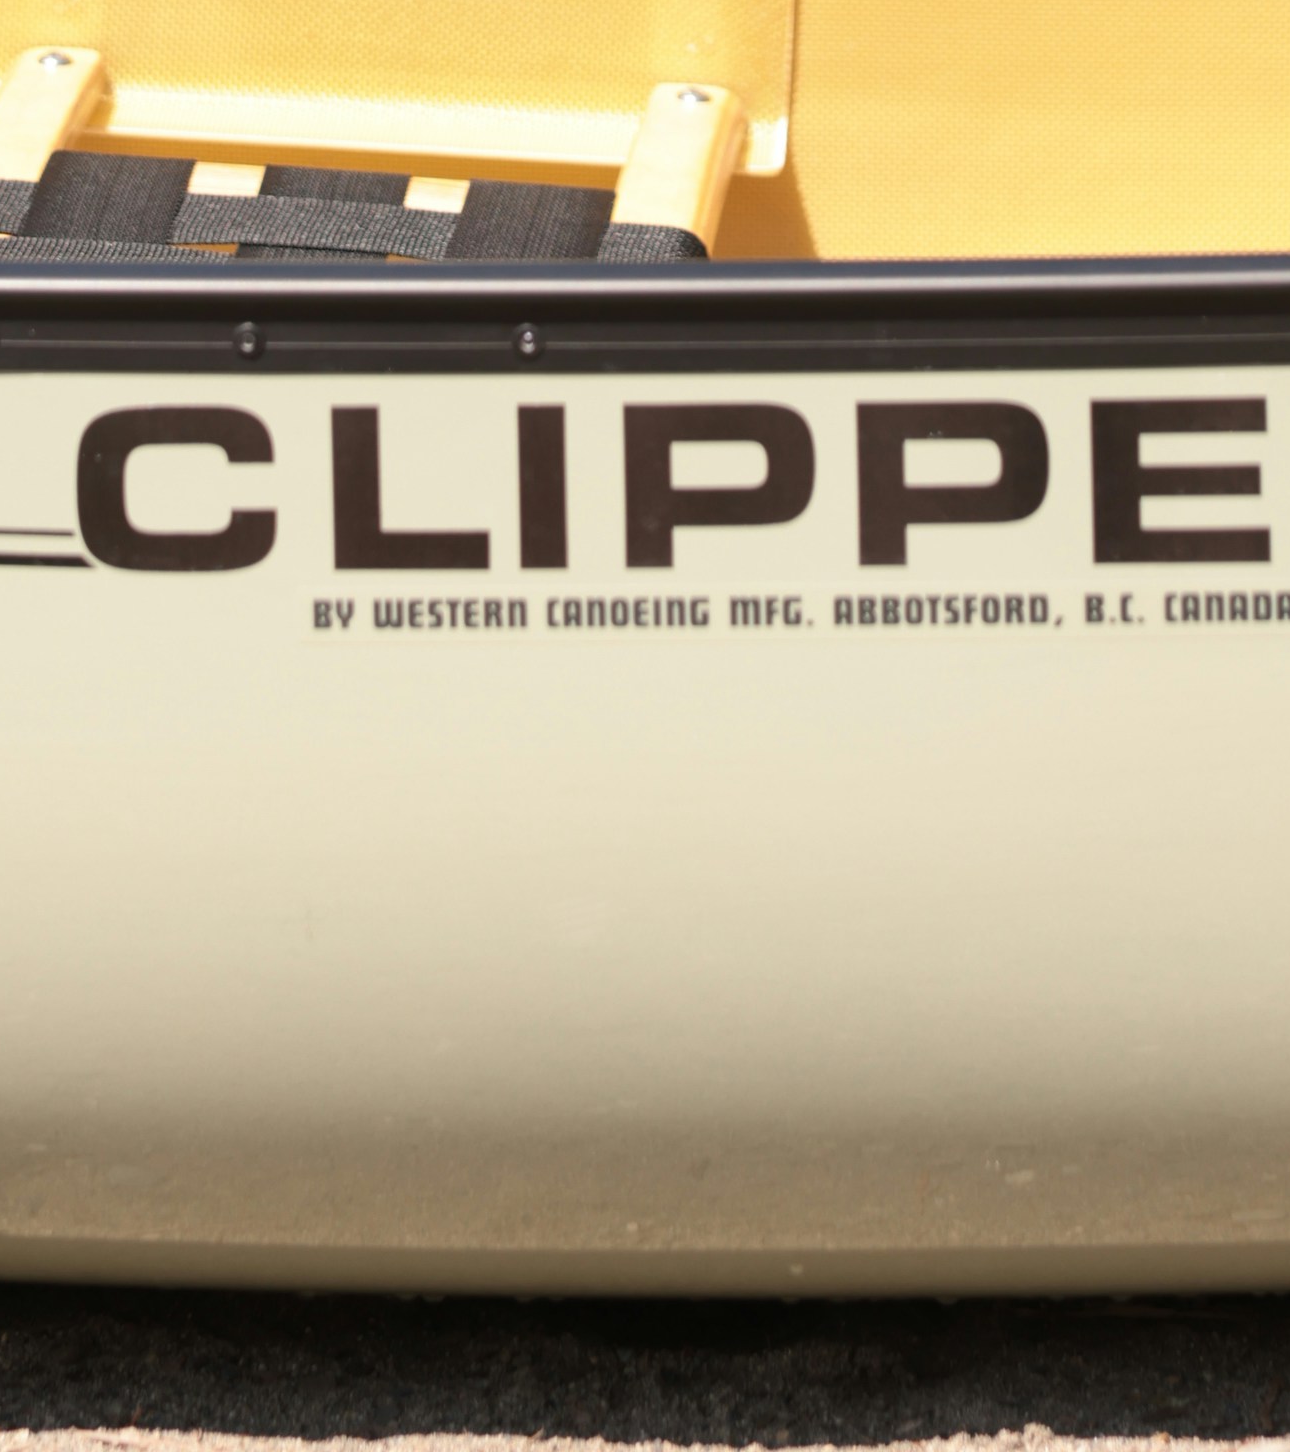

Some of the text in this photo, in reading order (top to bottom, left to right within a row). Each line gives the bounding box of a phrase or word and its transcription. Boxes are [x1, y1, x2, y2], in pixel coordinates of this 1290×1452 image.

[312, 599, 355, 629] BY
[372, 599, 528, 629] WESTERN
[546, 598, 710, 628] CANOEING
[729, 597, 815, 627] MFG.
[833, 594, 1063, 627] ABBOTSFORD,
[1084, 594, 1144, 624] B.C.
